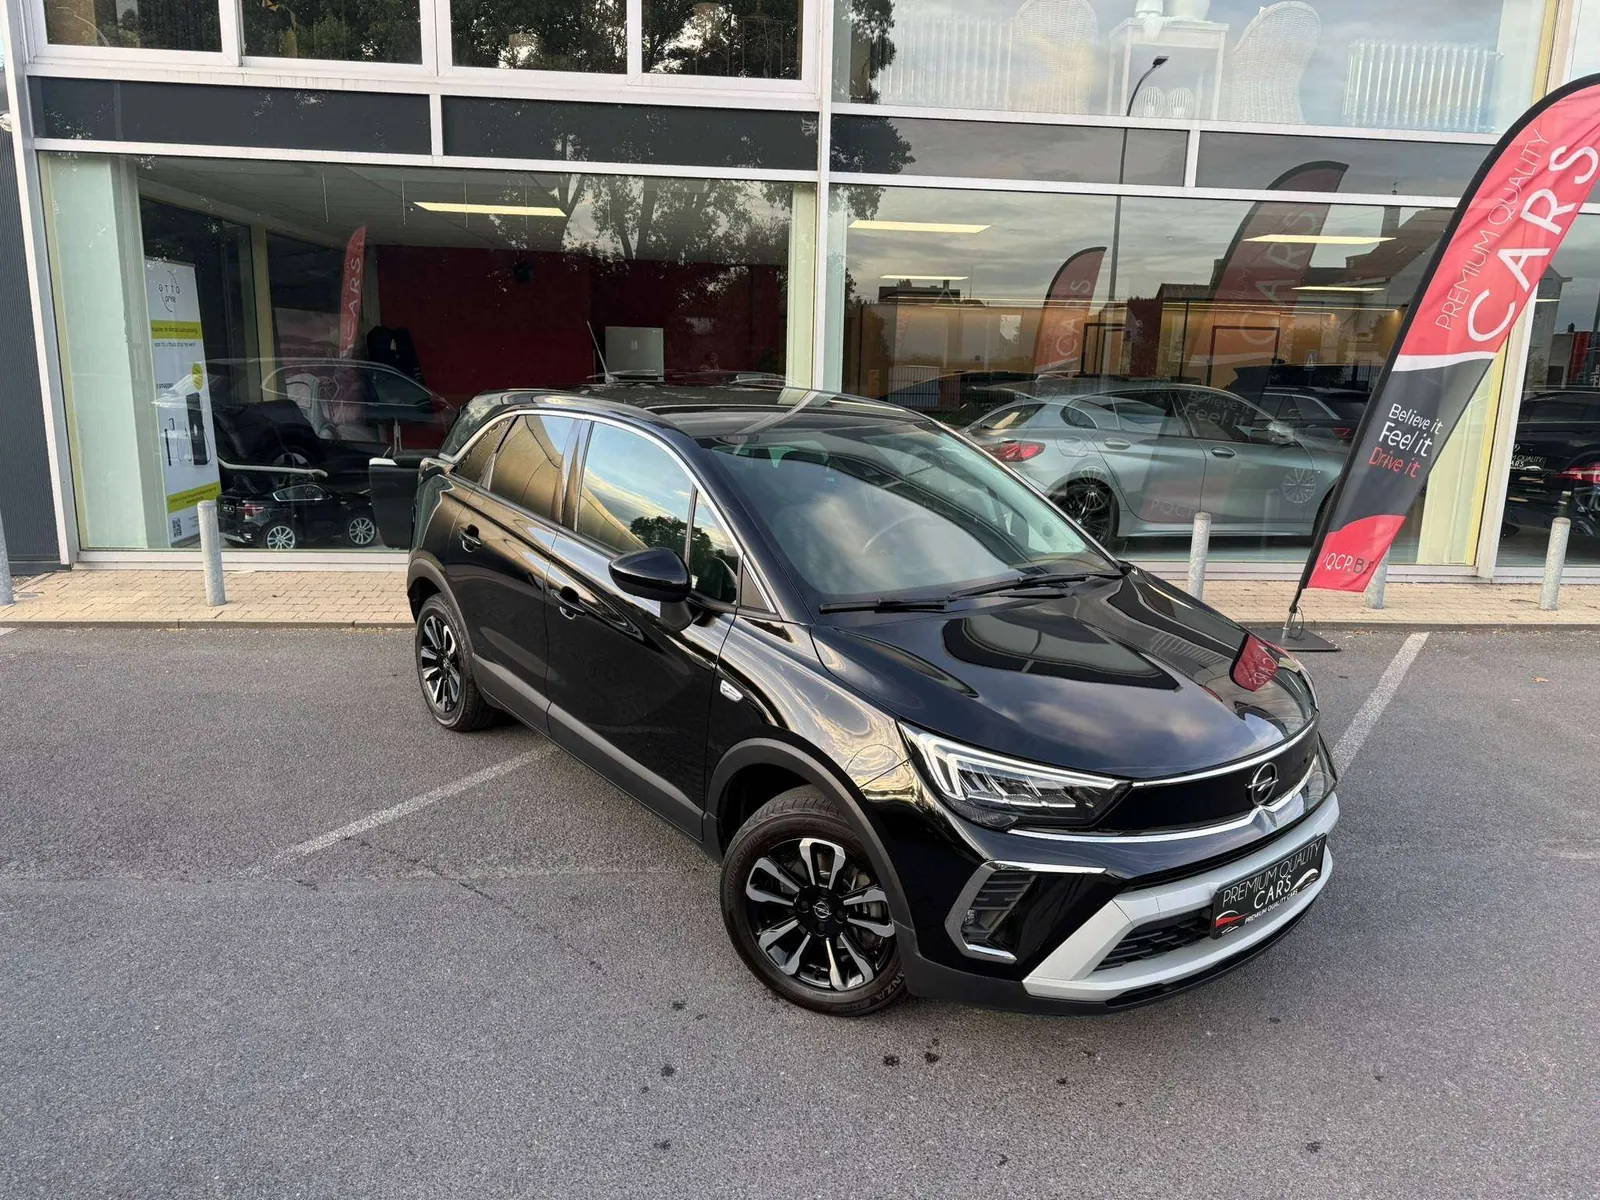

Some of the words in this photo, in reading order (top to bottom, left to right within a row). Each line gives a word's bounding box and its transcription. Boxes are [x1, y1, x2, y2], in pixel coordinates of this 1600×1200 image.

[1435, 231, 1501, 331] PREMIUM
[1488, 128, 1550, 226] QUALITY
[1467, 145, 1599, 343] CARS
[1185, 402, 1228, 426] Feel
[1388, 403, 1431, 430] Believe
[1430, 418, 1444, 435] it
[1378, 421, 1419, 451] Feel
[1414, 433, 1433, 457] it
[1368, 446, 1404, 472] Drive
[1404, 457, 1421, 478] it
[1323, 552, 1374, 574] QCP.B
[1222, 866, 1278, 908] PREMIUM
[1279, 840, 1322, 879] QUALITY
[1254, 875, 1291, 909] CARS
[876, 970, 905, 1001] ANZA
